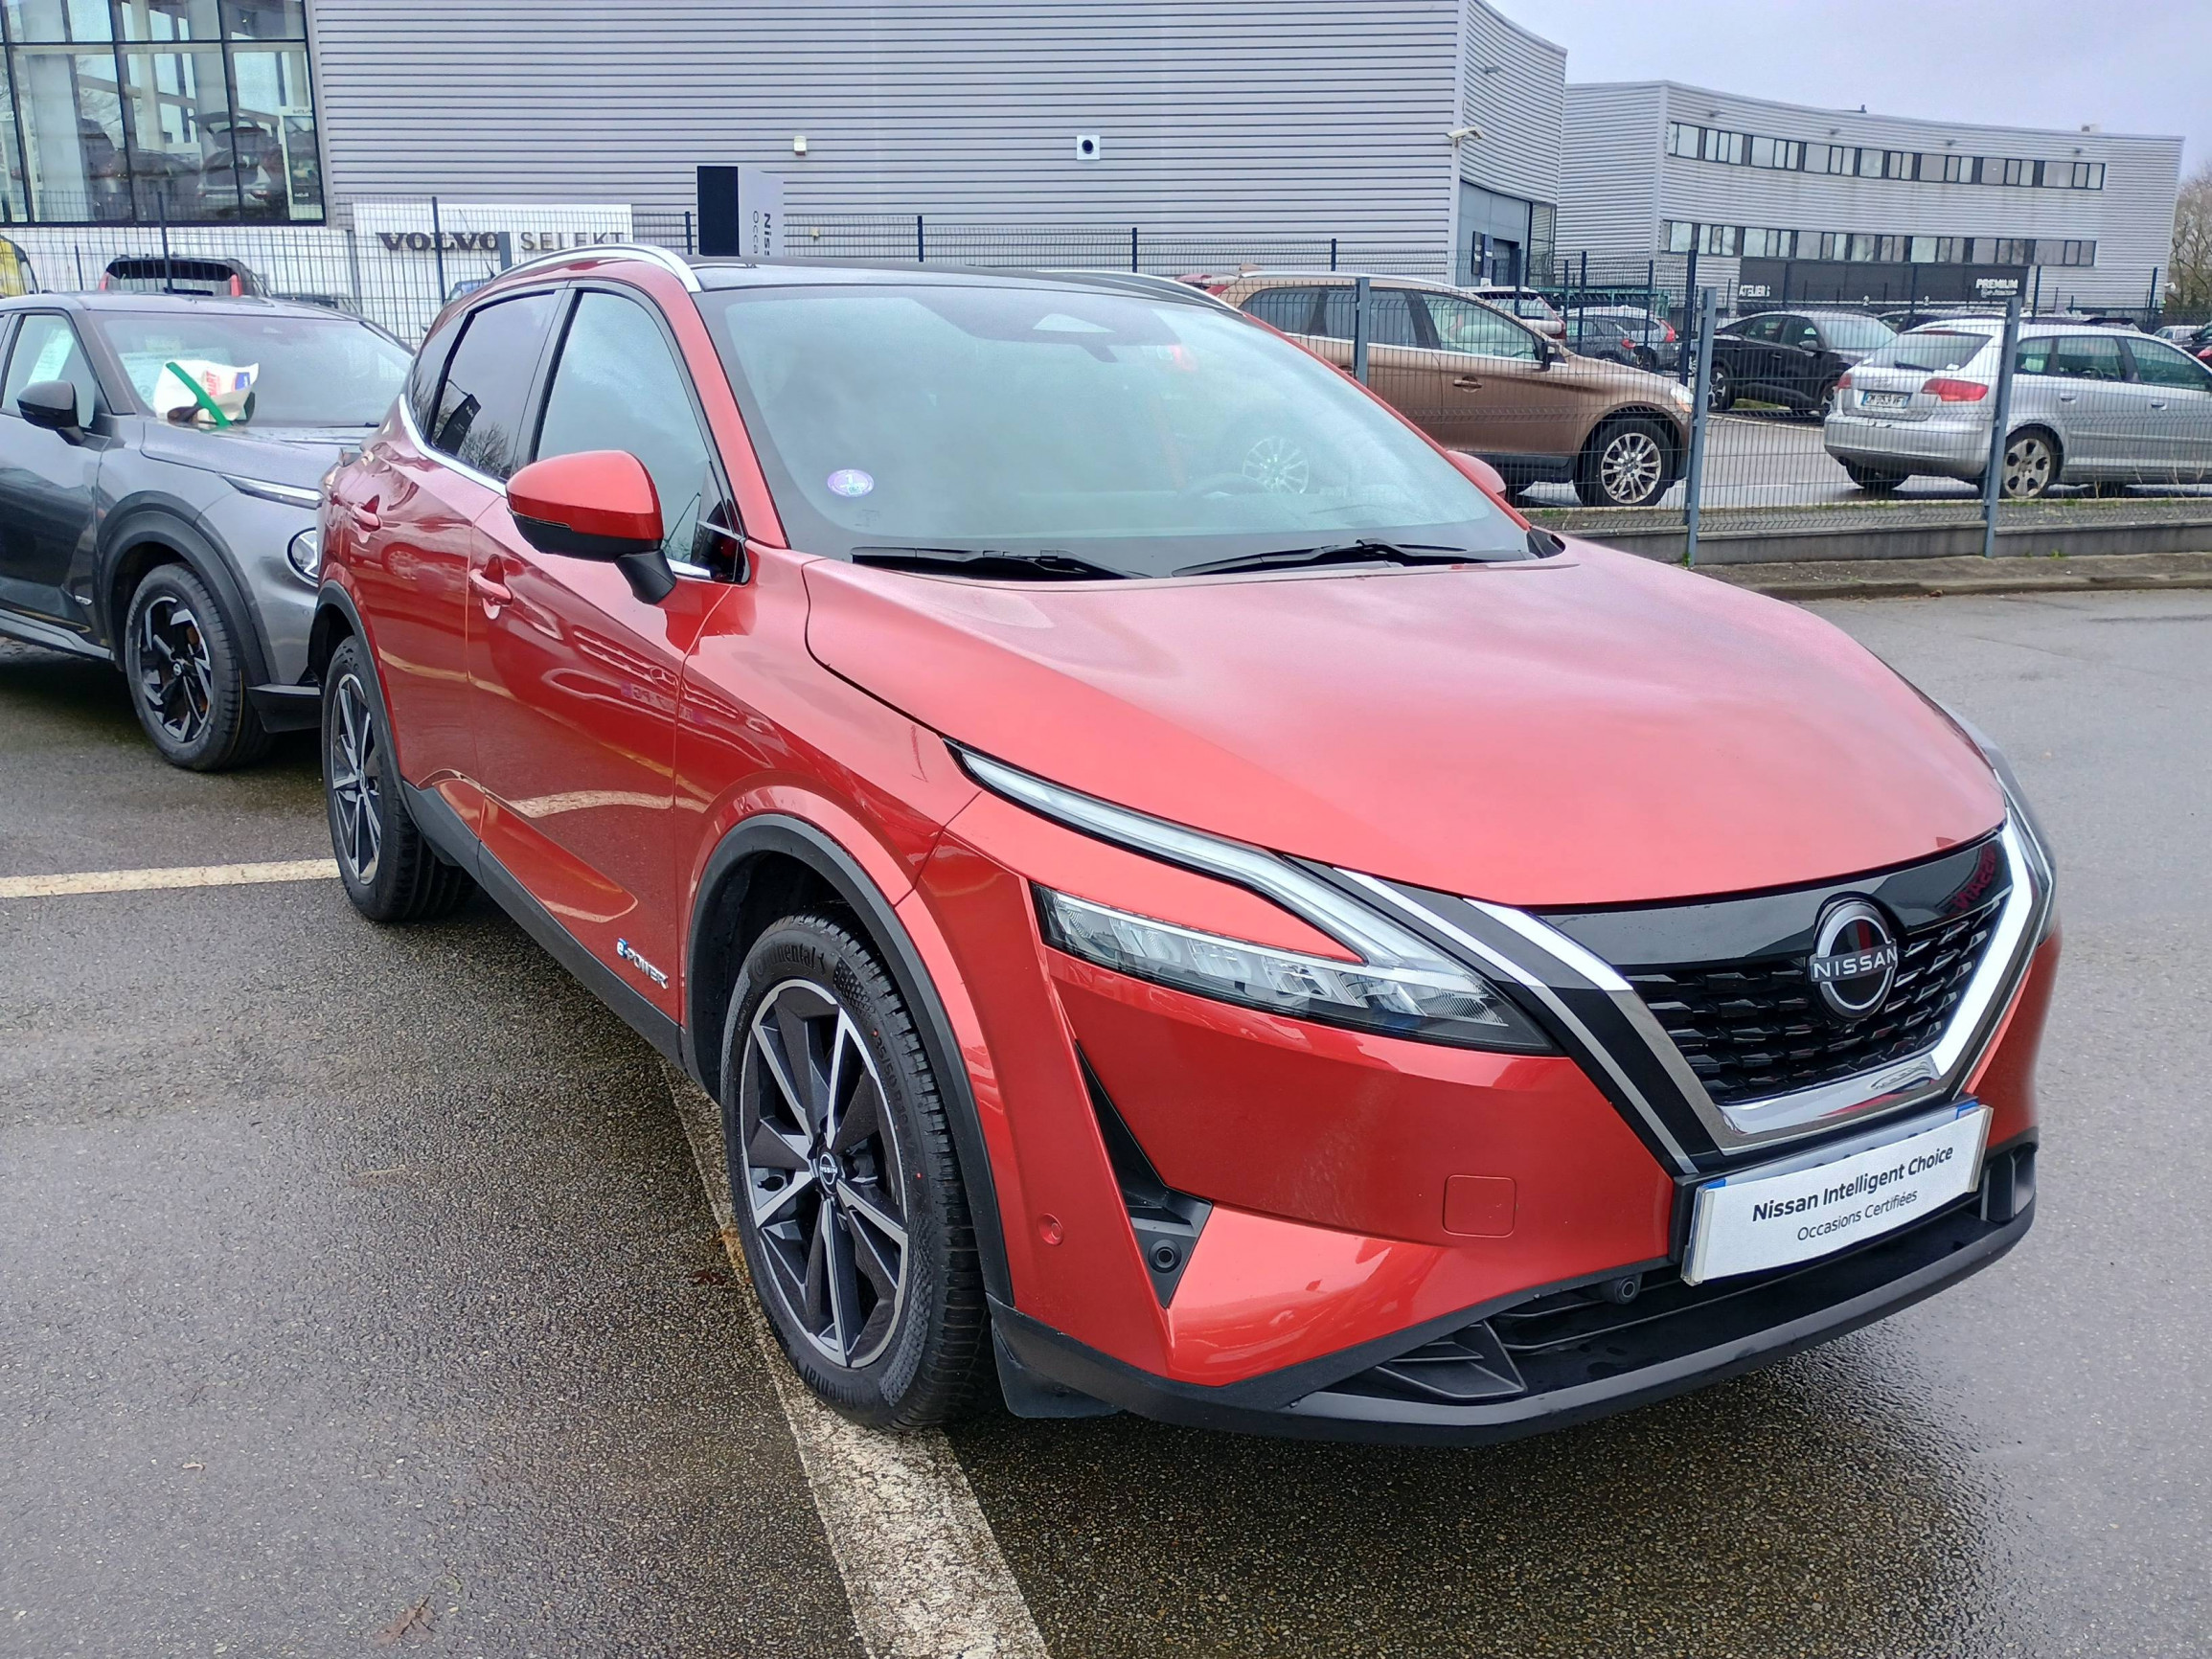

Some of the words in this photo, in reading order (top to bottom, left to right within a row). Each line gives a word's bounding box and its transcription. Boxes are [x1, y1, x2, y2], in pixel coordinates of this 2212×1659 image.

[376, 232, 499, 252] VOLVO
[520, 231, 625, 251] SELEKT
[1975, 278, 2018, 289] PREMIUM
[1813, 945, 1897, 979] NISSAN
[1752, 1193, 1818, 1222] Nissan
[1823, 1162, 1905, 1206] Intelligent
[1907, 1146, 1954, 1176] Choice
[1797, 1211, 1862, 1241] Occasions
[1864, 1190, 1918, 1219] Certifiées
